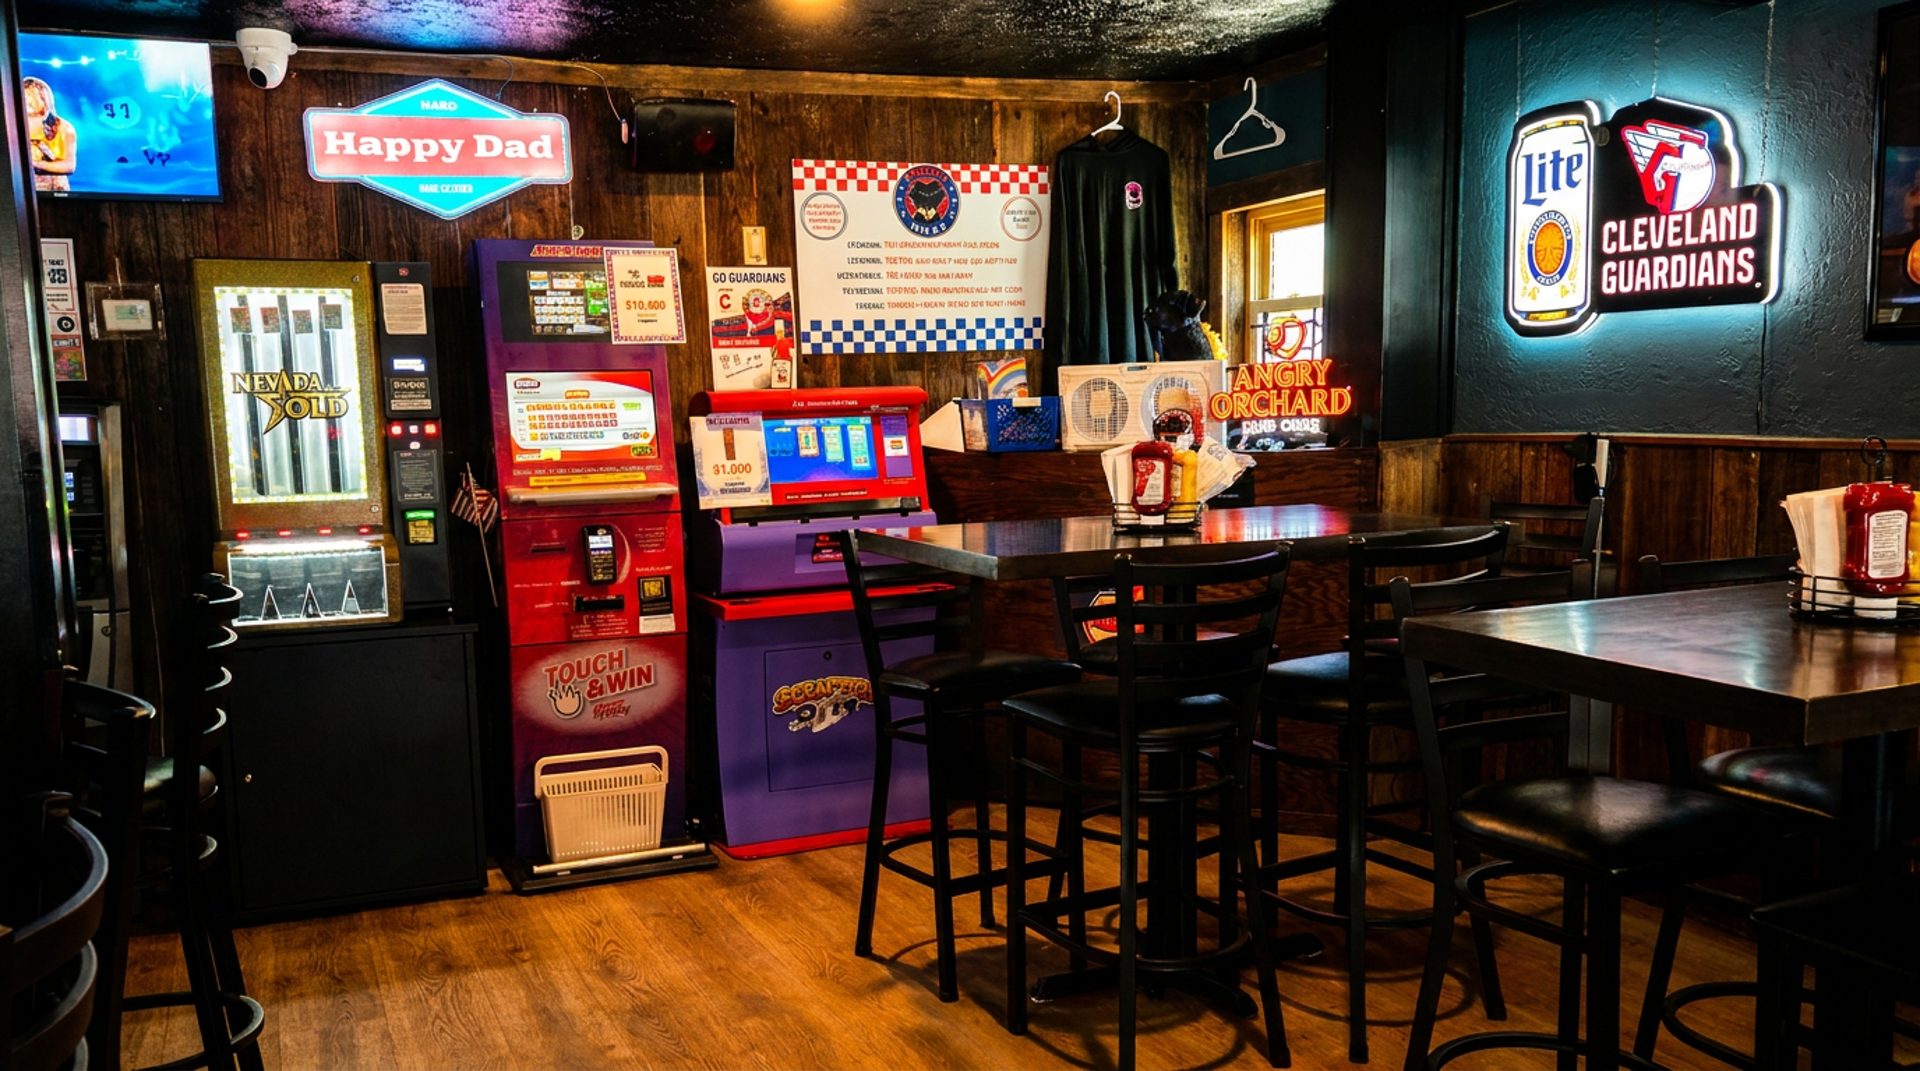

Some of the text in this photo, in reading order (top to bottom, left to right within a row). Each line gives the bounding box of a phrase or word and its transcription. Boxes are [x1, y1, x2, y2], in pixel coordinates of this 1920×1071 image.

[323, 130, 555, 164] Happy Dad
[1521, 149, 1583, 207] Lite
[1602, 202, 1758, 254] CLEVELAND
[712, 272, 787, 284] GO GUARDIANS
[1601, 247, 1755, 295] GUARDIANS
[719, 293, 732, 310] C
[230, 368, 323, 394] NEVADA
[1233, 357, 1333, 391] ANGRY
[1210, 387, 1352, 421] ORCHARD
[543, 647, 625, 688] TOUCH
[586, 663, 654, 700] & WIN
